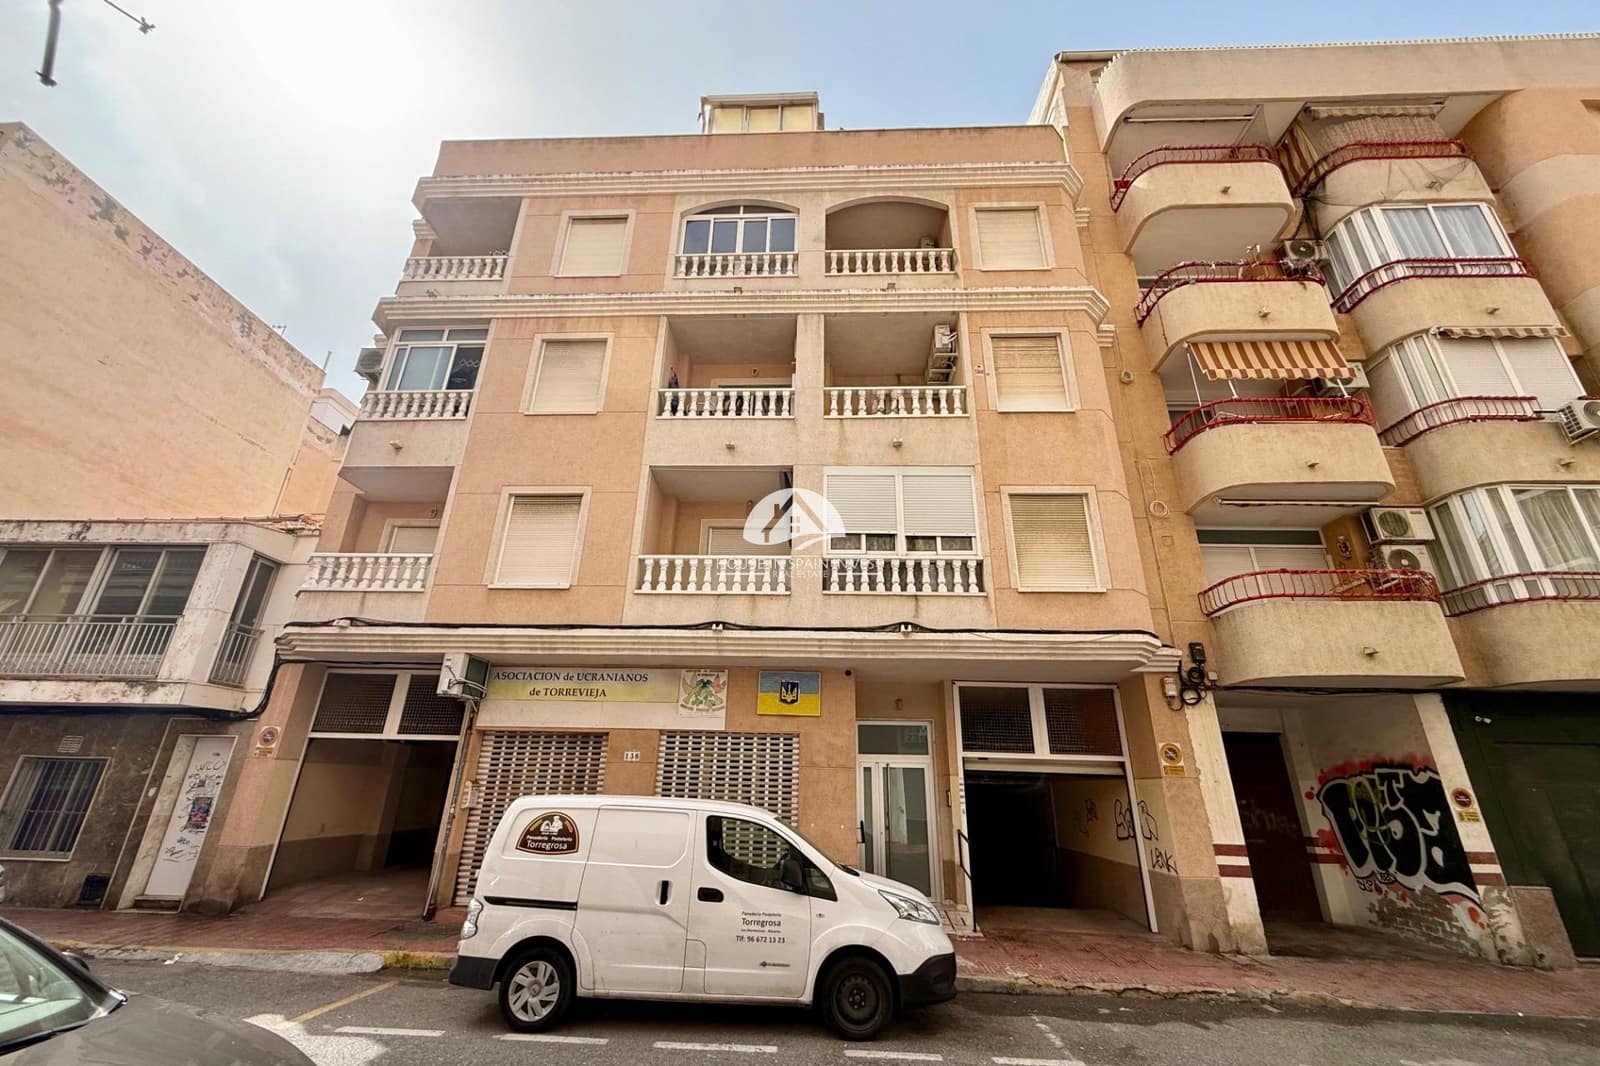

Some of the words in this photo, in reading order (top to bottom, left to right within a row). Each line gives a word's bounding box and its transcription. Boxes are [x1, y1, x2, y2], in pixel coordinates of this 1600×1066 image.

[494, 671, 561, 681] ASOCIACION
[563, 672, 575, 681] de
[576, 672, 649, 682] UCRANIANOS
[529, 687, 541, 696] de
[543, 687, 607, 699] TORREVIEJA
[527, 840, 568, 850] Torregrosa
[741, 917, 781, 928] Torregrosa
